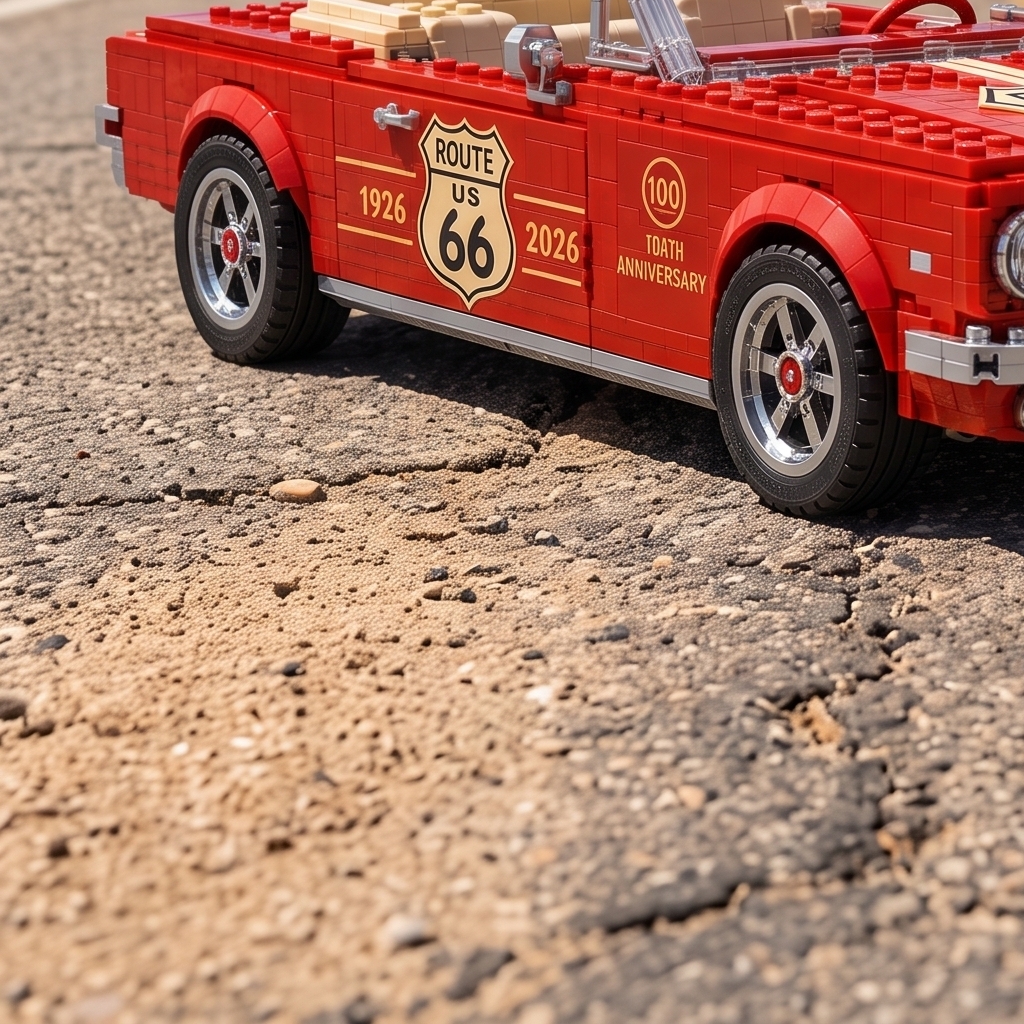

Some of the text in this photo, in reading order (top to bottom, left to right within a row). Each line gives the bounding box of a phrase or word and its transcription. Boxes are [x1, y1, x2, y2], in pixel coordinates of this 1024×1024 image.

[435, 137, 495, 175] ROUTE
[359, 186, 407, 224] 1926
[451, 182, 480, 207] US
[647, 175, 681, 210] 100
[438, 208, 495, 278] 66
[525, 221, 580, 264] 2026
[645, 234, 685, 262] TOATH
[616, 259, 707, 295] ANNIVERSARY
